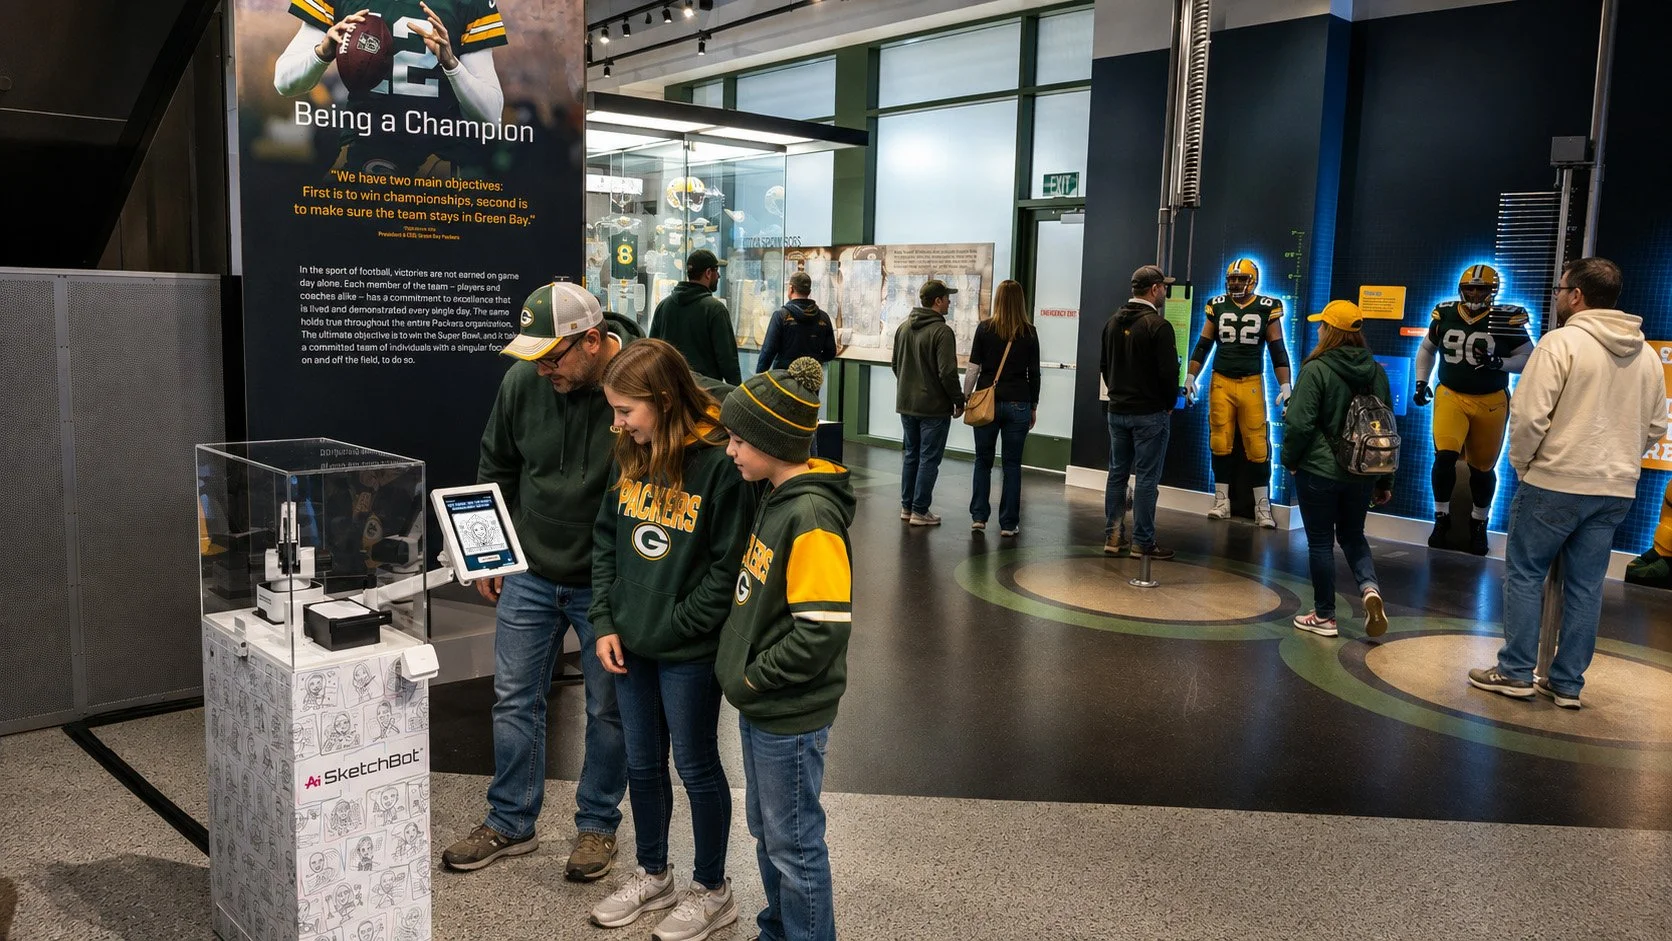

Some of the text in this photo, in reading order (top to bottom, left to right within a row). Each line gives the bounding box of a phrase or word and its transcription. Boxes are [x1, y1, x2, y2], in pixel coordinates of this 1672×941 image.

[371, 16, 440, 98] 2
[294, 101, 534, 144] Being a Champion
[358, 172, 387, 184] have
[389, 175, 411, 186] two
[414, 176, 442, 188] main
[445, 178, 504, 191] objectives:
[1050, 175, 1071, 195] EXIT
[302, 186, 528, 209] First is to win championships, second is
[294, 204, 307, 215] to
[310, 204, 344, 216] make
[346, 208, 373, 217] sure
[376, 208, 395, 219] the
[398, 209, 427, 220] team
[430, 212, 459, 223] stays
[462, 212, 472, 222] in
[474, 212, 506, 224] Green
[617, 244, 634, 265] 8
[300, 266, 308, 274] In
[310, 266, 324, 275] the
[325, 266, 347, 277] sport
[349, 267, 358, 275] of
[360, 267, 392, 277] football,
[394, 268, 428, 277] victories
[444, 270, 457, 278] not
[459, 270, 485, 279] earned
[498, 273, 519, 282] game
[300, 279, 315, 289] day
[317, 279, 342, 288] alone.
[344, 280, 365, 288] Each
[367, 280, 401, 289] member
[402, 281, 411, 289] of
[413, 281, 426, 290] the
[427, 281, 448, 290] team
[457, 282, 485, 293] players
[486, 283, 500, 291] and
[300, 291, 336, 300] coaches
[337, 292, 357, 301] alike
[366, 293, 380, 301] has
[390, 293, 441, 302] commitment
[443, 294, 451, 303] to
[495, 295, 511, 304] that
[300, 304, 308, 313] is
[310, 304, 329, 313] lived
[331, 305, 346, 313] and
[349, 305, 407, 314] demonstrated
[408, 308, 430, 317] every
[431, 307, 454, 317] single
[456, 307, 472, 318] day.
[473, 307, 487, 316] The
[300, 318, 324, 326] holds
[326, 318, 342, 326] true
[344, 318, 390, 328] throughout
[391, 318, 405, 326] the
[407, 318, 430, 327] entire
[432, 319, 464, 327] Packers
[1219, 312, 1262, 344] 62
[301, 330, 316, 339] The
[319, 330, 352, 339] ultimate
[354, 331, 390, 341] objective
[391, 331, 398, 339] is
[400, 331, 408, 339] to
[409, 331, 422, 339] win
[424, 331, 436, 339] the
[438, 331, 460, 341] Super
[483, 331, 497, 339] and
[309, 343, 354, 351] committed
[356, 343, 378, 351] team
[380, 343, 388, 351] of
[389, 343, 431, 351] individuals
[433, 343, 449, 351] with
[457, 343, 487, 353] singular
[1442, 328, 1496, 366] 90
[314, 355, 330, 364] and
[332, 355, 343, 364] off
[345, 355, 358, 364] the
[360, 355, 380, 365] field,
[382, 355, 390, 364] to
[391, 355, 402, 364] do
[618, 478, 702, 534] PACKERS
[633, 525, 669, 558] G
[736, 570, 750, 602] G
[324, 748, 420, 784] SketchBot
